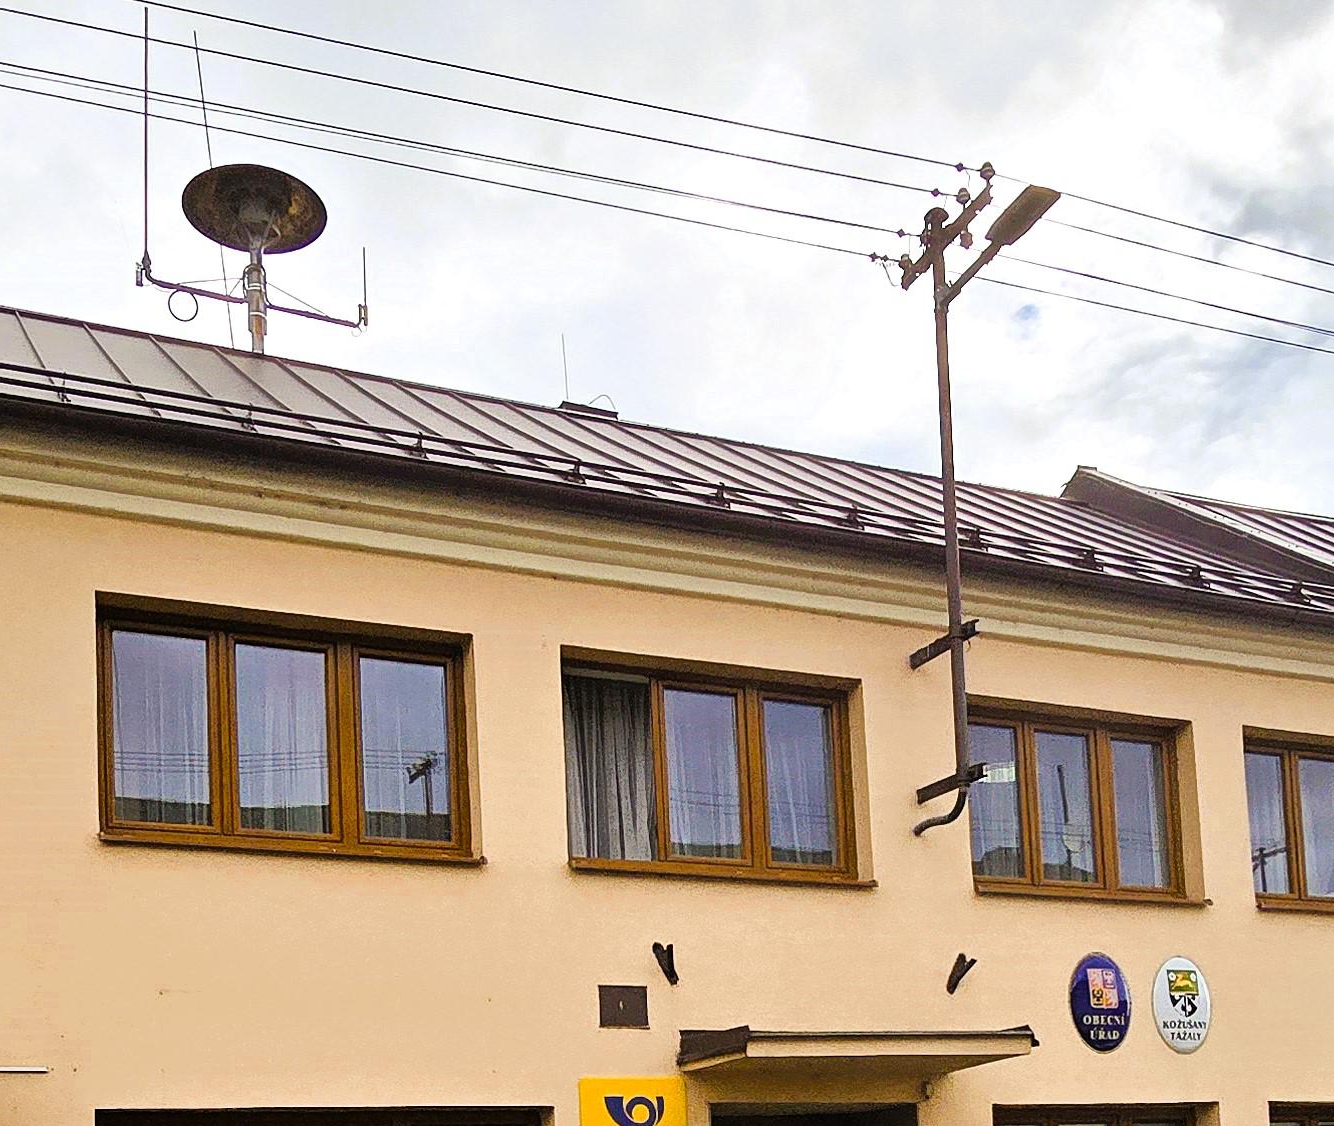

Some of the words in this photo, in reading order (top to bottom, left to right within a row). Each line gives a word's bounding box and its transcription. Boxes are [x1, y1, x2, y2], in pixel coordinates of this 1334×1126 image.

[1082, 1012, 1126, 1025] OBECNÍ
[1162, 1019, 1207, 1030] KOŽUŠANY
[1089, 1026, 1121, 1040] ÚŘAD
[1170, 1030, 1202, 1041] TAŽALY
